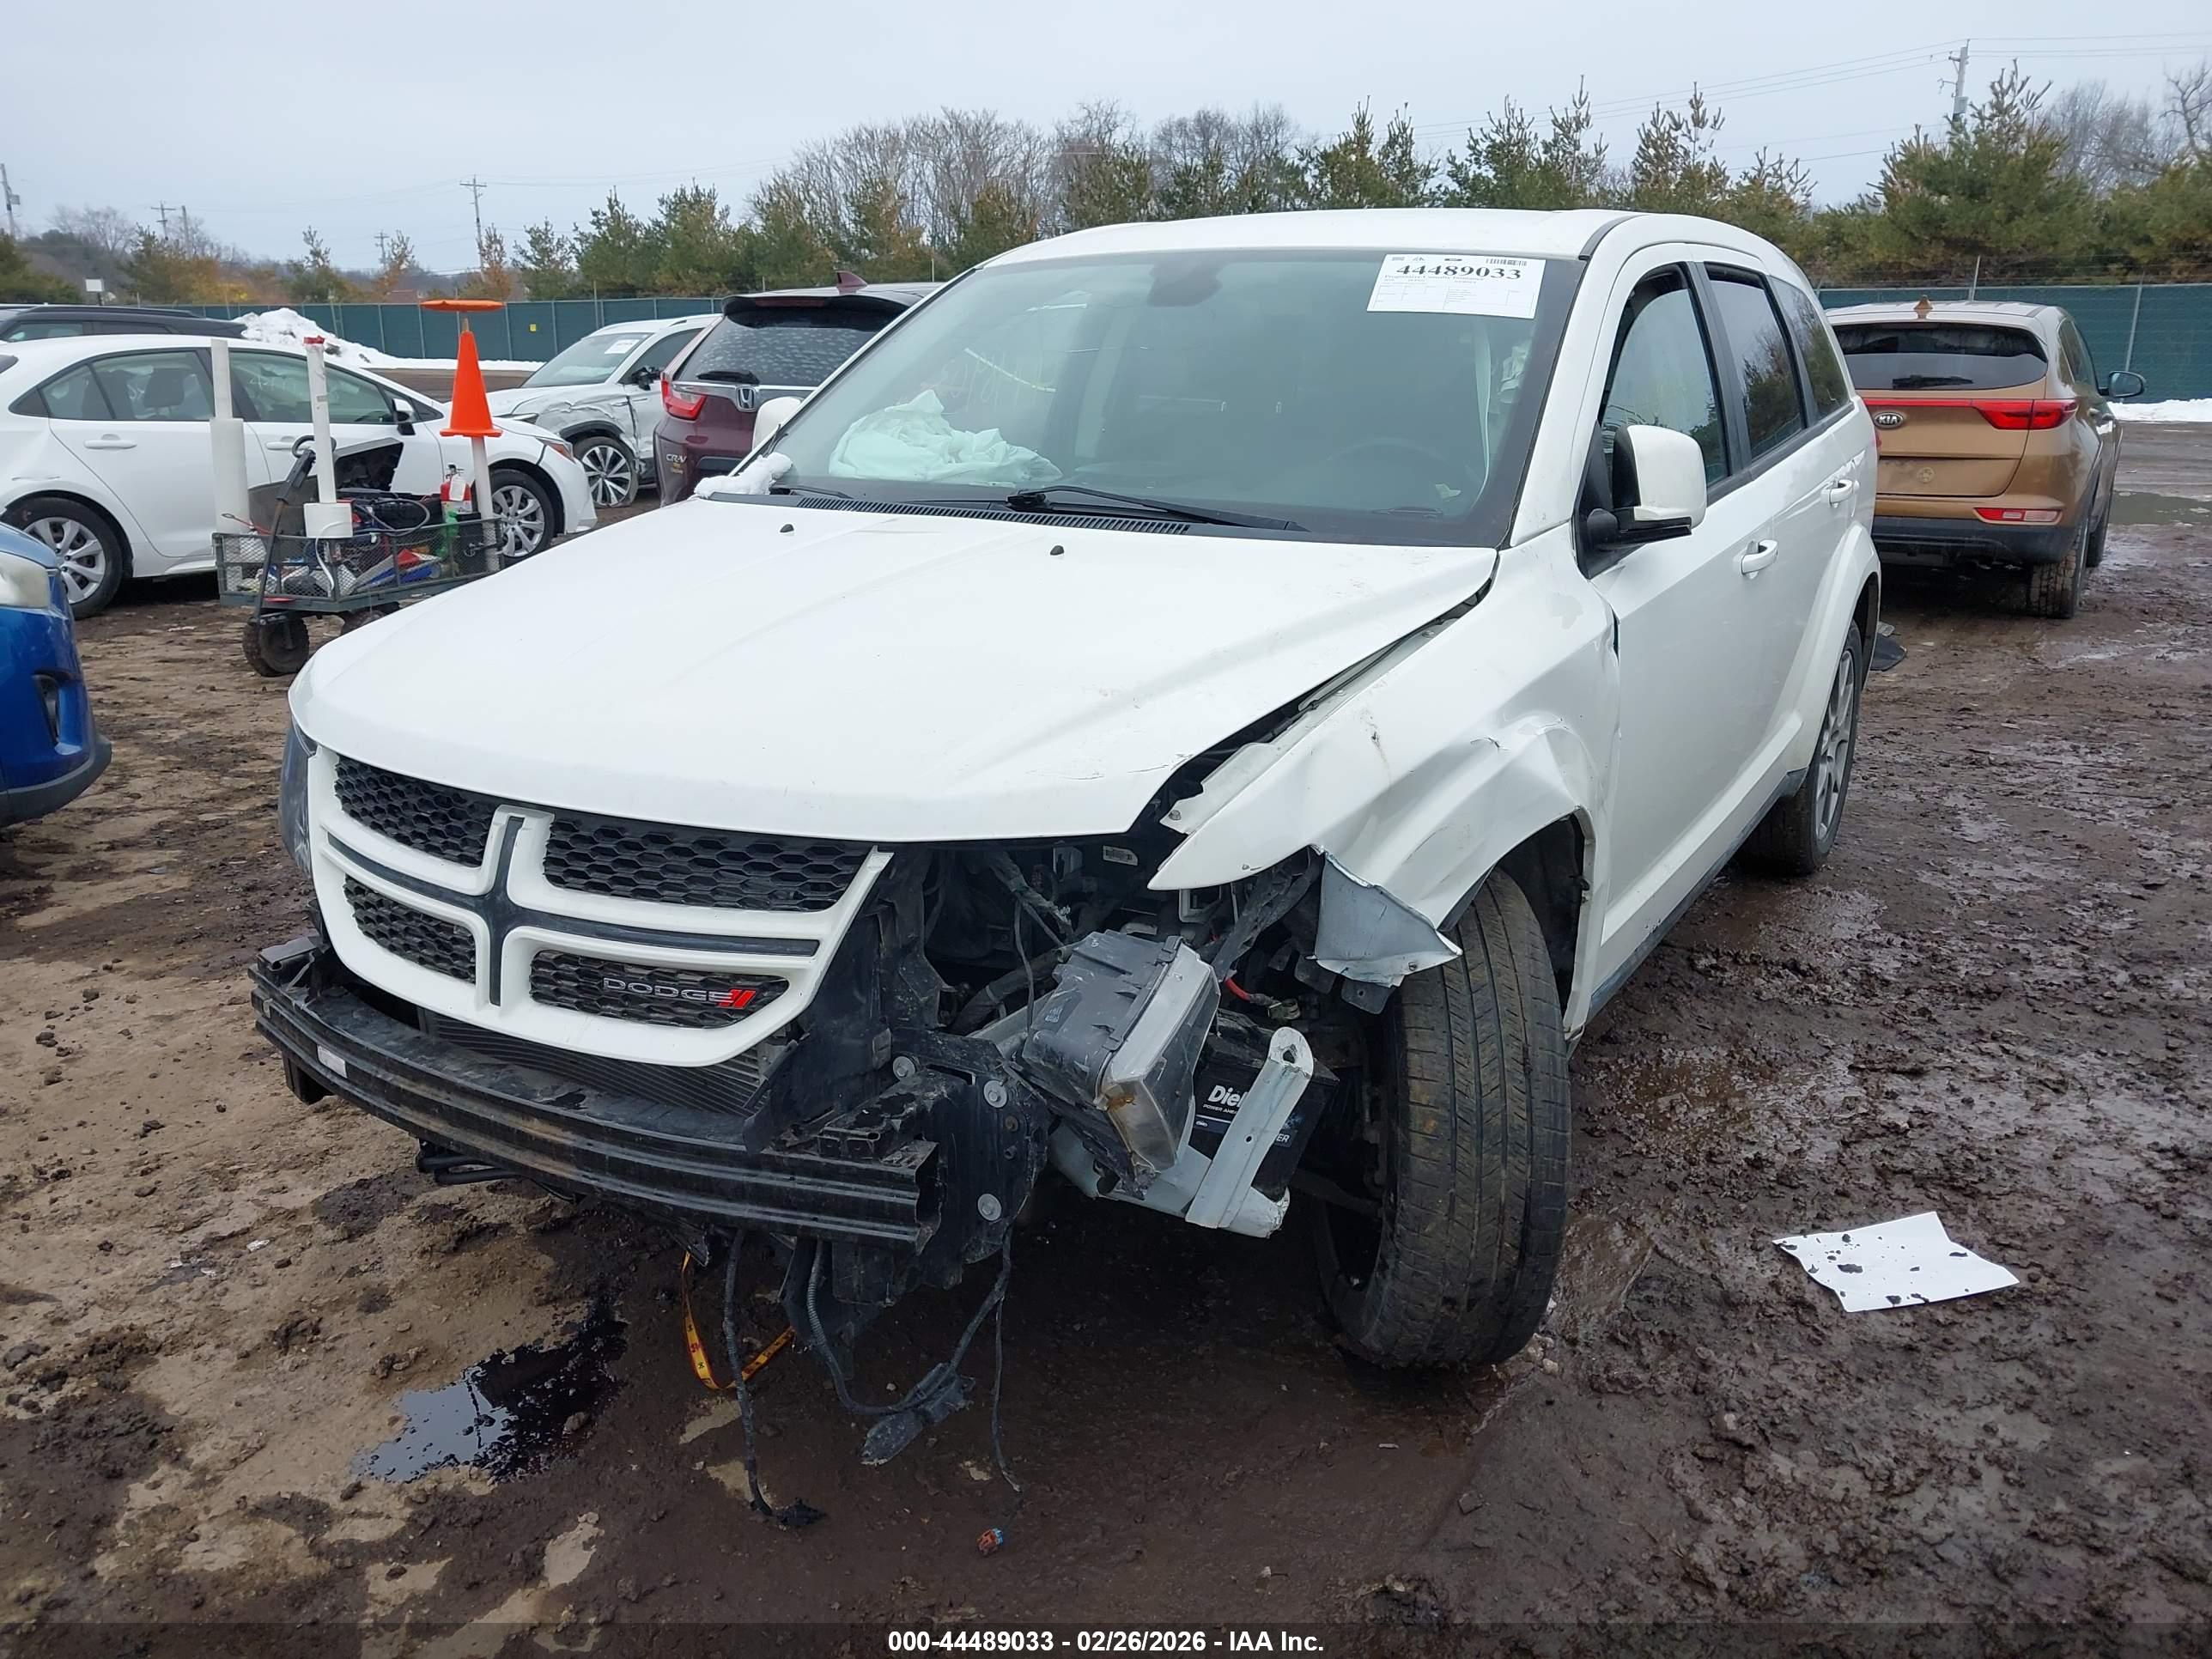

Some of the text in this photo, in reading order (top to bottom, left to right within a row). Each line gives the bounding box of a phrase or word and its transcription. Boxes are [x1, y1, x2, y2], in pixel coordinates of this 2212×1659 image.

[1396, 264, 1521, 280] 44489033
[1879, 416, 1898, 424] KIA
[603, 977, 734, 1003] DODGE
[1203, 1103, 1222, 1112] POWER
